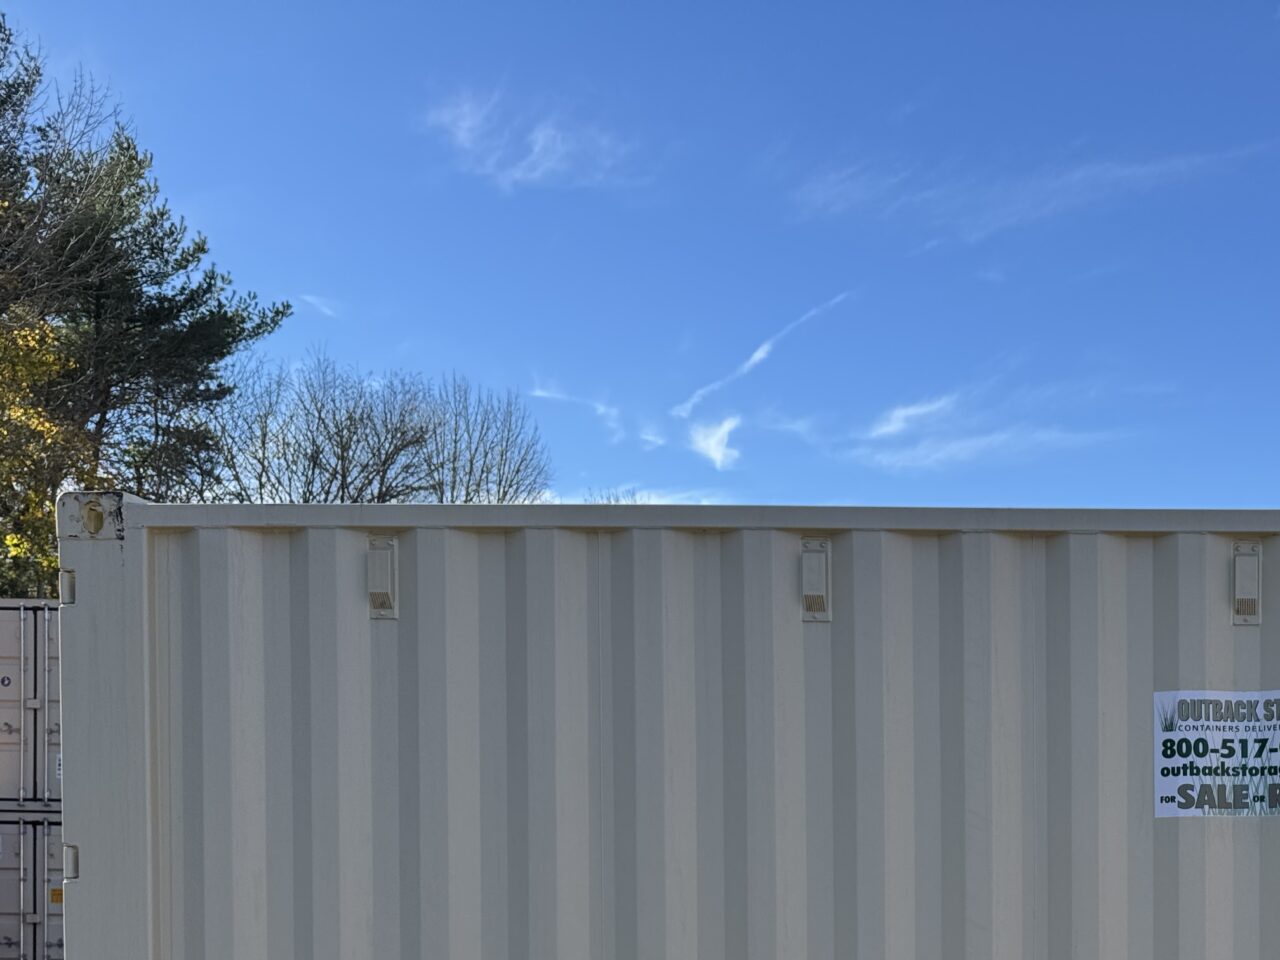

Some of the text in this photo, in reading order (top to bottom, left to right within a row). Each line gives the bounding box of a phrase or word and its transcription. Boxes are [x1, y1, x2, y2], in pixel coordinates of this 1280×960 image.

[1177, 698, 1261, 722] OUTBACK
[1178, 724, 1240, 733] CONTAINERS
[1160, 795, 1176, 804] FOR
[1177, 783, 1250, 810] SALE
[1252, 795, 1266, 803] OR
